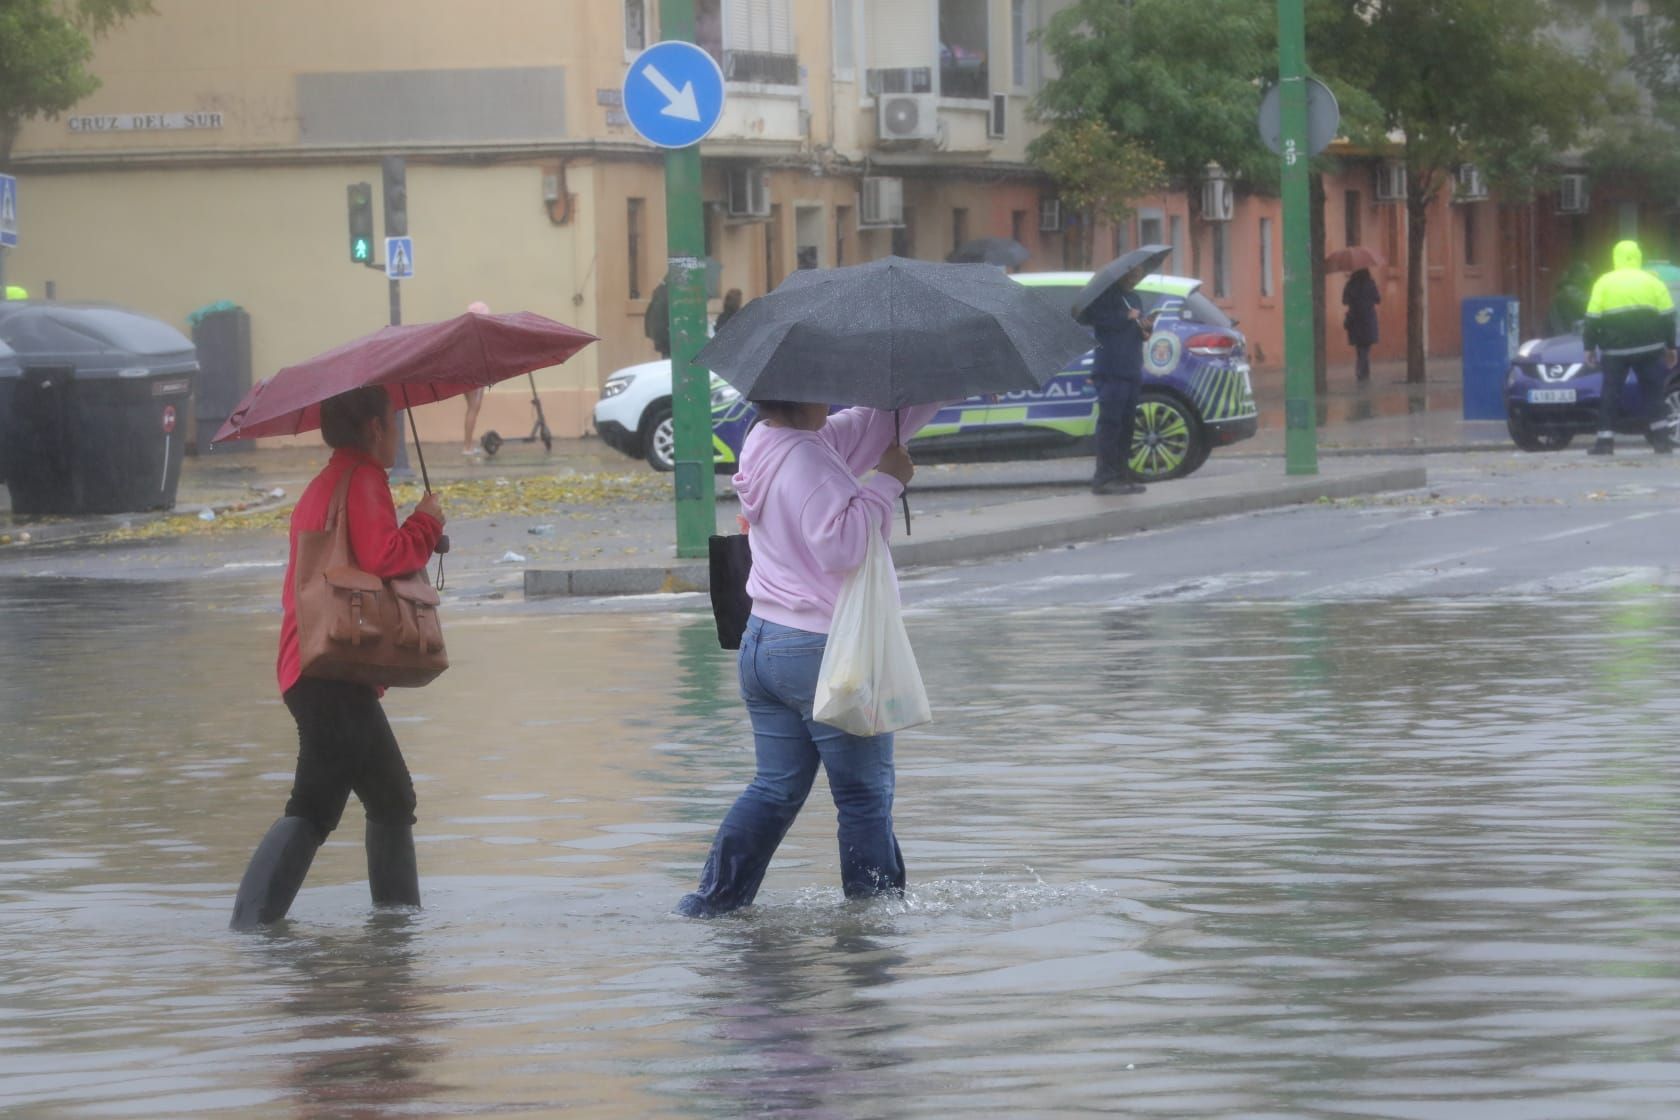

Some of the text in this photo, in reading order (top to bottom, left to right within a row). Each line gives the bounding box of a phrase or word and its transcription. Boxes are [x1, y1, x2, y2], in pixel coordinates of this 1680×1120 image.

[68, 113, 221, 131] CRUZ DEL SUR
[997, 382, 1081, 400] OCAL
